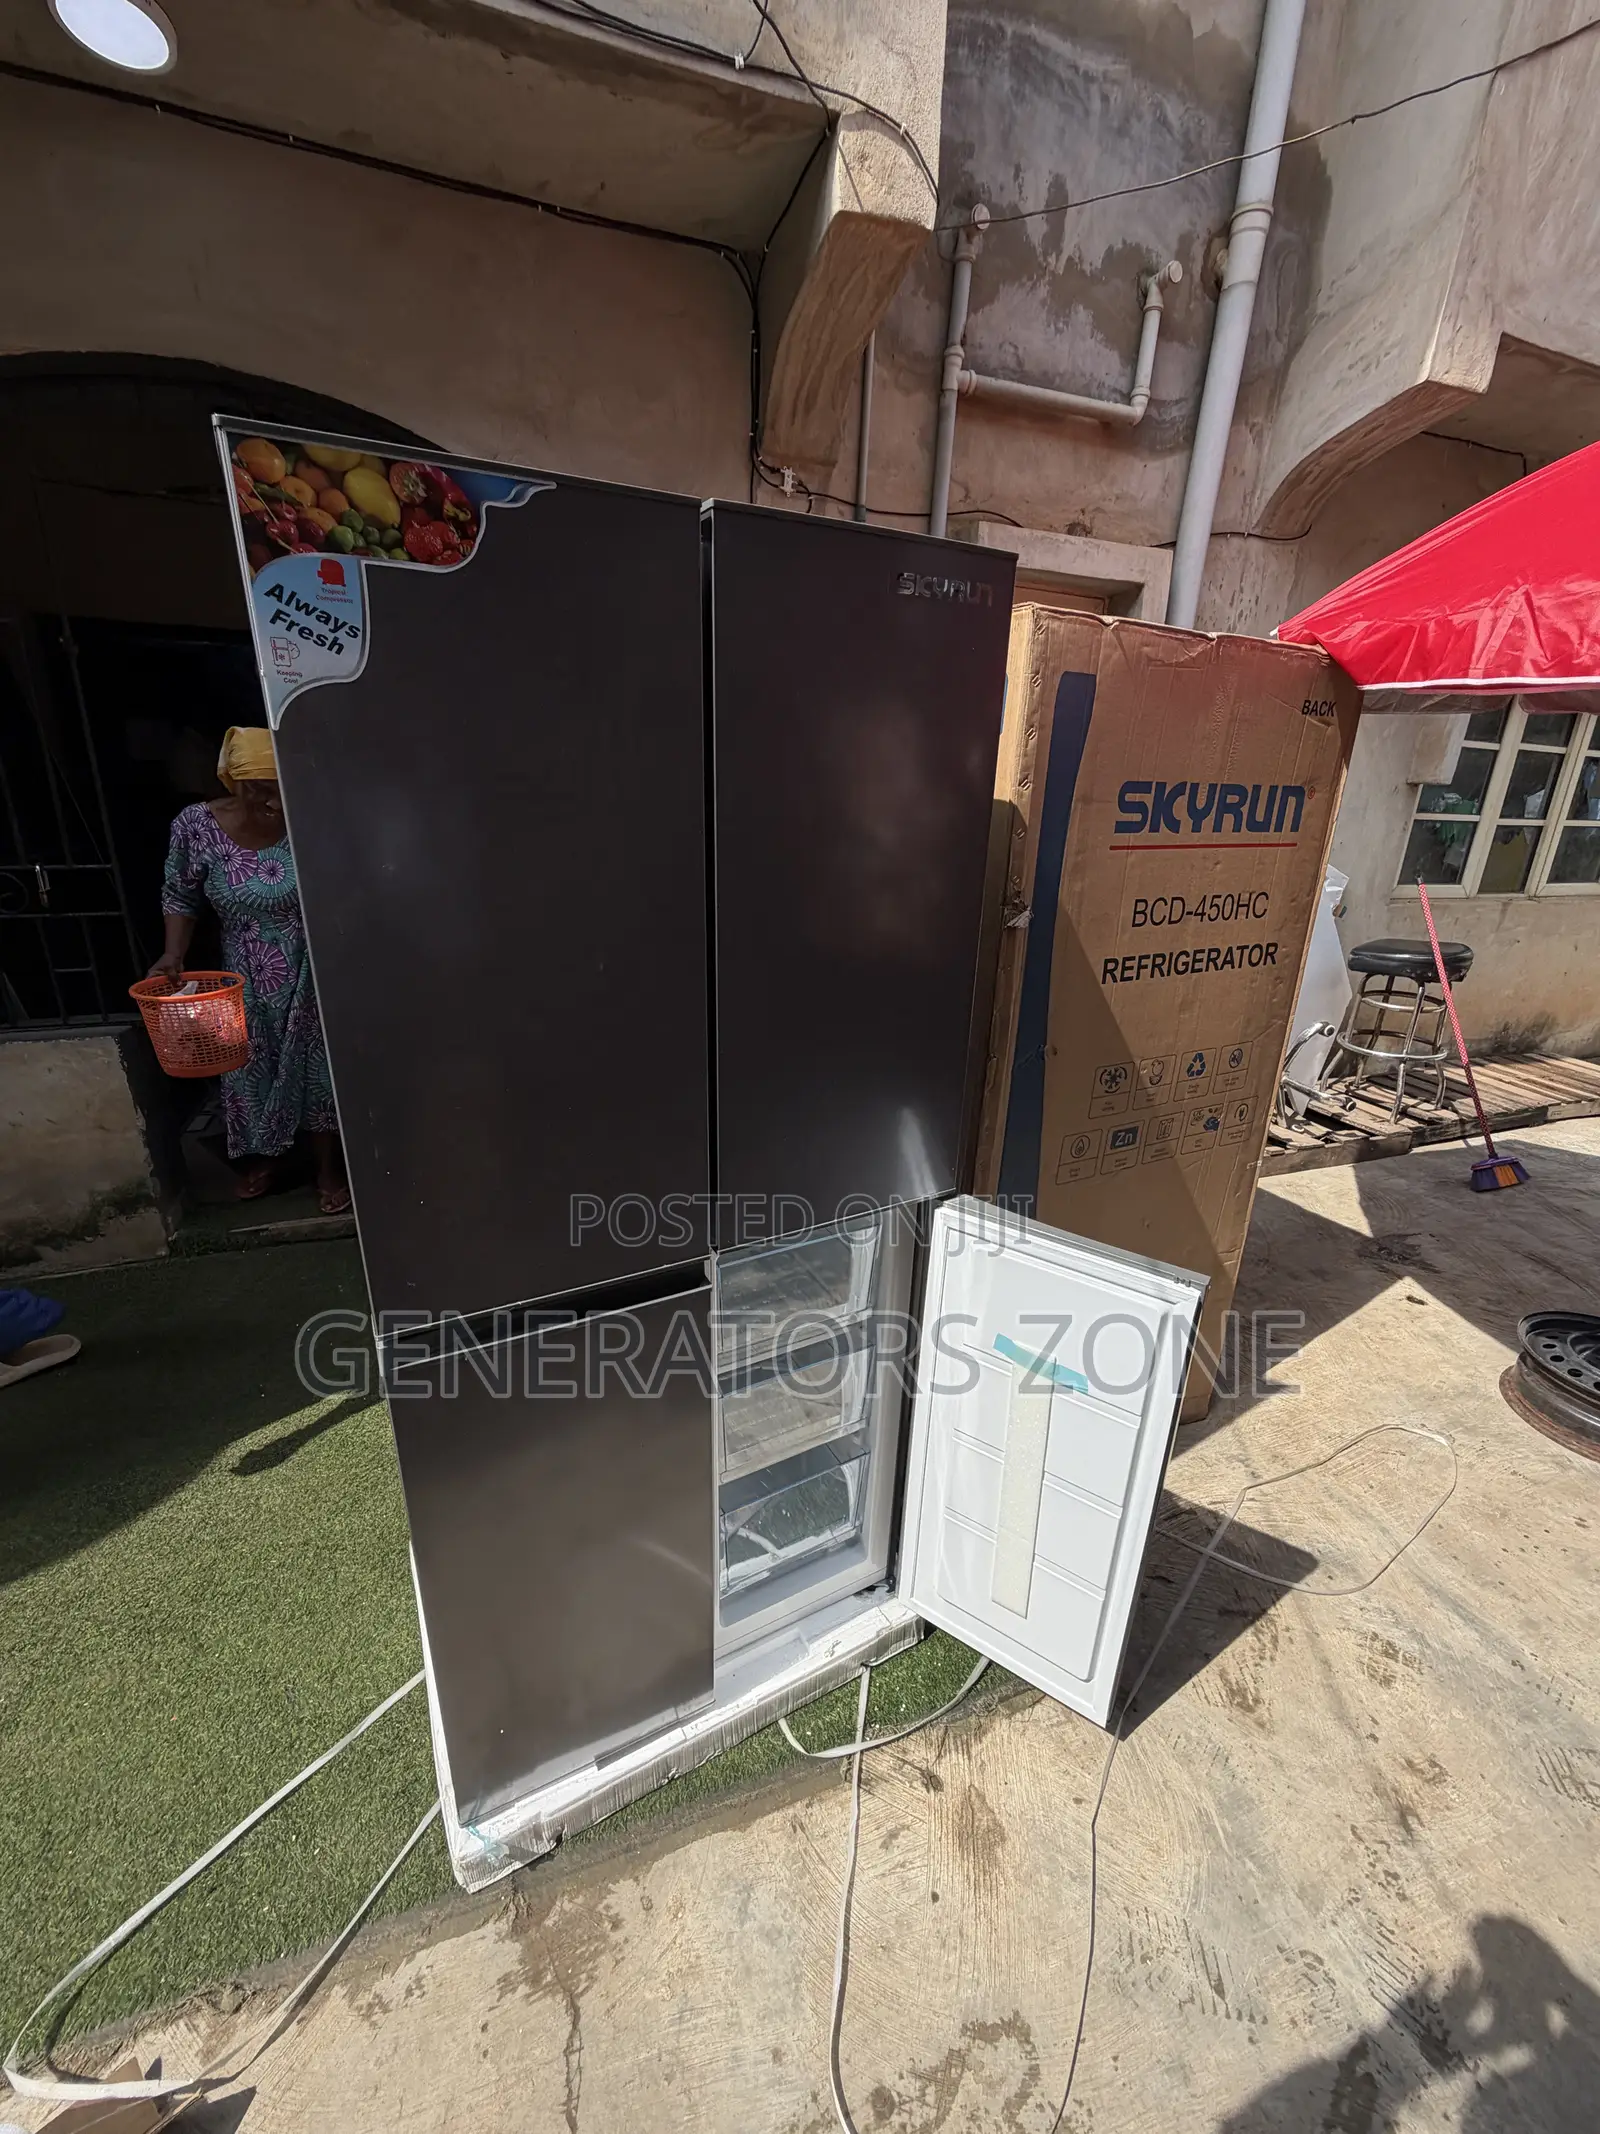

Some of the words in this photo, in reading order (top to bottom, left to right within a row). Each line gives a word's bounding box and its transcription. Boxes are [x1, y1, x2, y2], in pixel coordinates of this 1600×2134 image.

[897, 572, 993, 607] SKYRUN
[264, 583, 361, 639] Always
[269, 609, 345, 656] Fresh
[1301, 700, 1336, 717] BACK
[1114, 780, 1305, 834] SKYRUN
[1131, 891, 1269, 928] BCD-450HC
[1101, 942, 1279, 985] REFRIGERATOR
[1114, 1131, 1134, 1147] Zn
